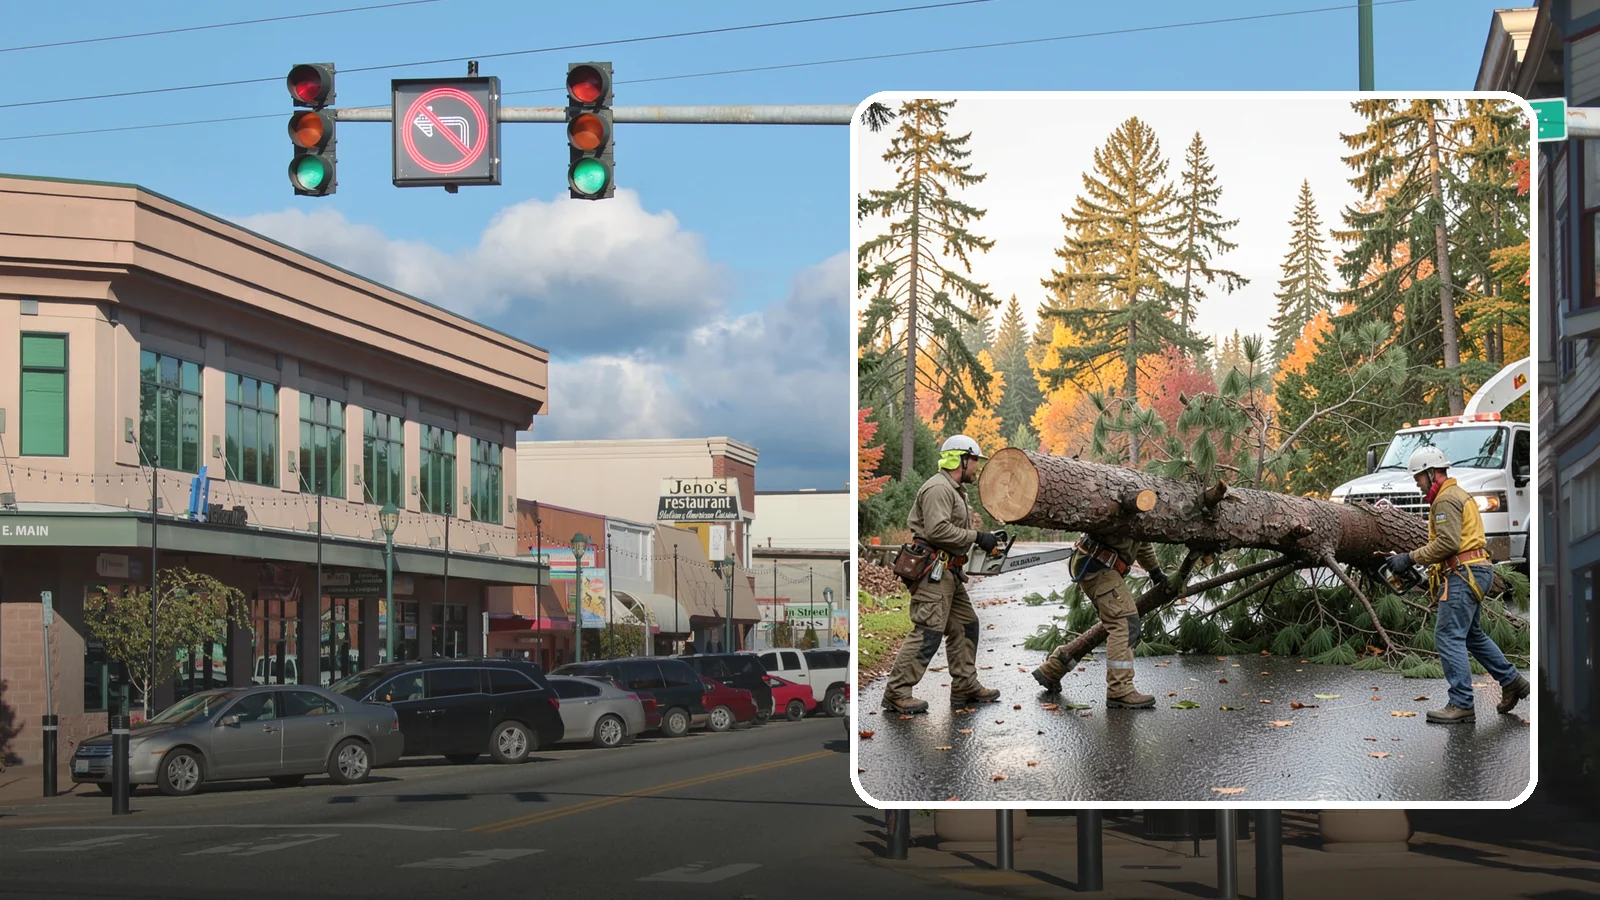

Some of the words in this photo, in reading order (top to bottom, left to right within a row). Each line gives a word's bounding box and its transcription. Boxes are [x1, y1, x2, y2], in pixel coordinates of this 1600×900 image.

[670, 480, 727, 494] Jeno's
[665, 496, 731, 509] restaurant
[658, 510, 681, 519] Italian
[686, 510, 715, 519] American
[715, 509, 737, 519] Cuisine
[2, 525, 13, 536] E.
[15, 525, 49, 536] MAIN
[797, 607, 828, 616] Street
